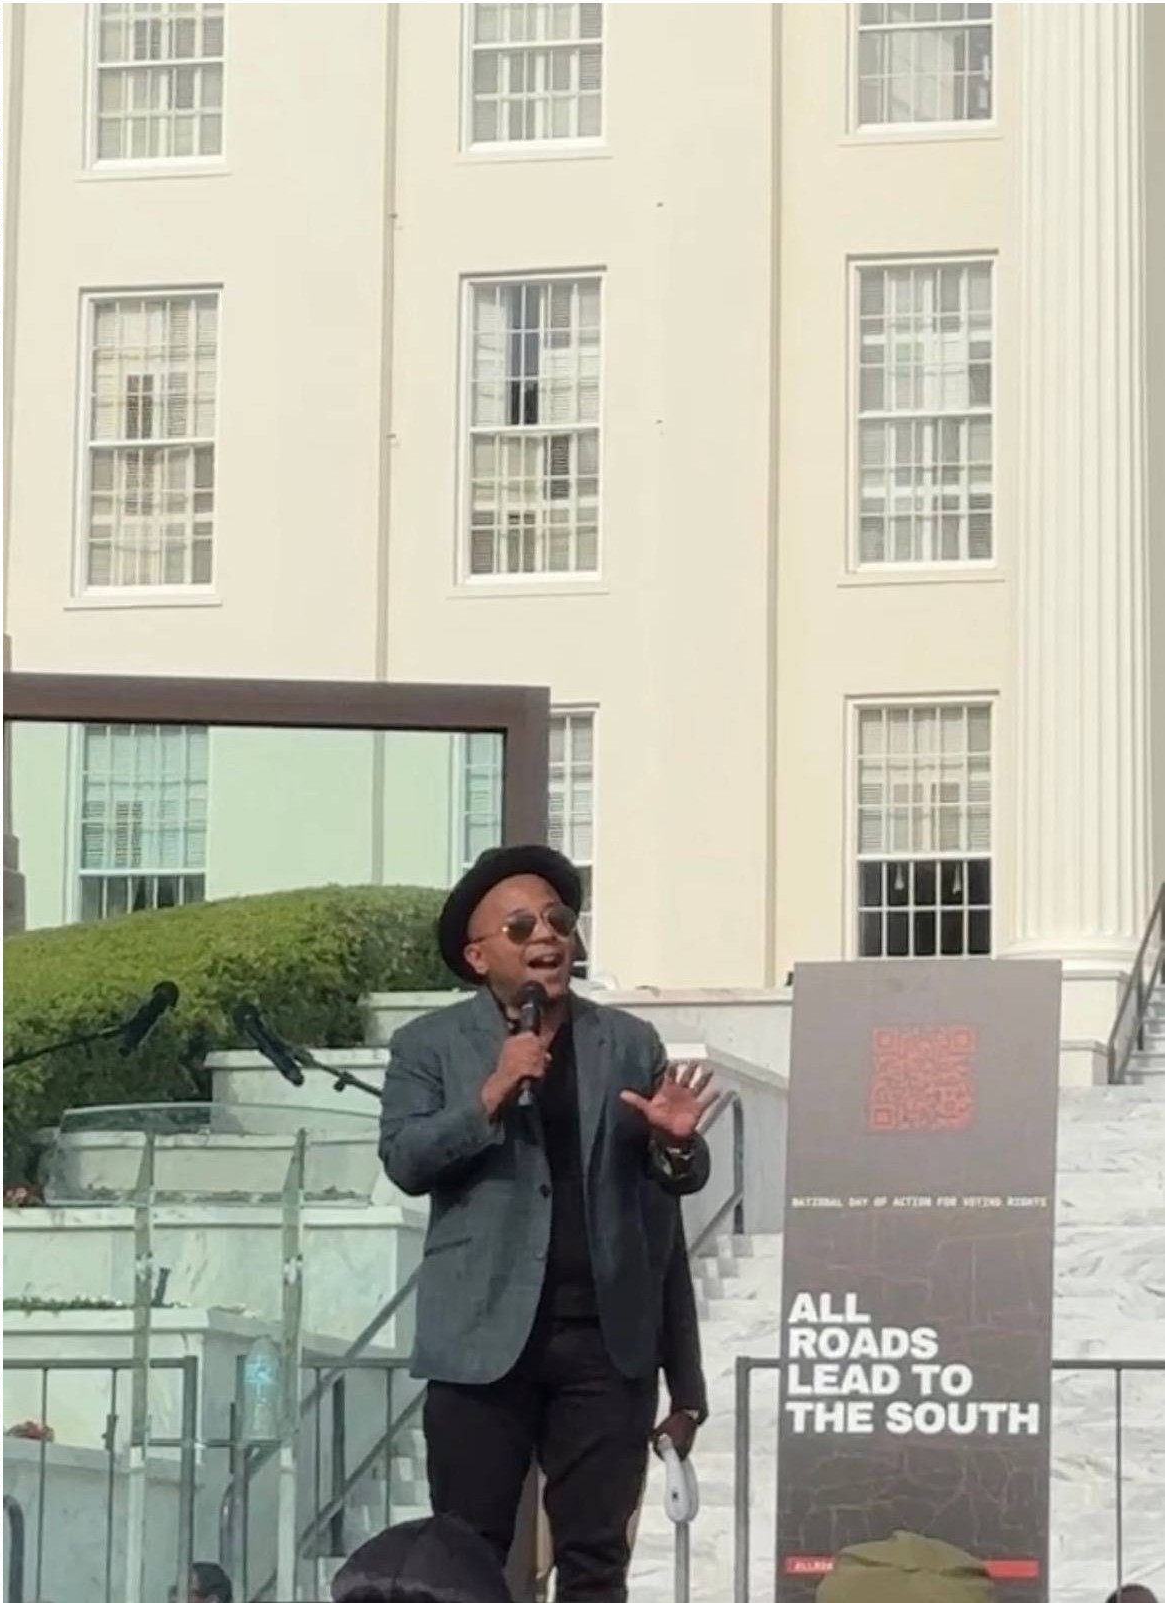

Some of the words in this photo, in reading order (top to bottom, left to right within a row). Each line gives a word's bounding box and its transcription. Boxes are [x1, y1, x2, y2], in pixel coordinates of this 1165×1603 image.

[788, 1292, 871, 1323] ALL
[788, 1327, 939, 1360] ROADS
[787, 1364, 901, 1396] LEAD
[912, 1364, 973, 1396] TO
[785, 1401, 875, 1433] THE
[885, 1401, 1039, 1435] SOUTH
